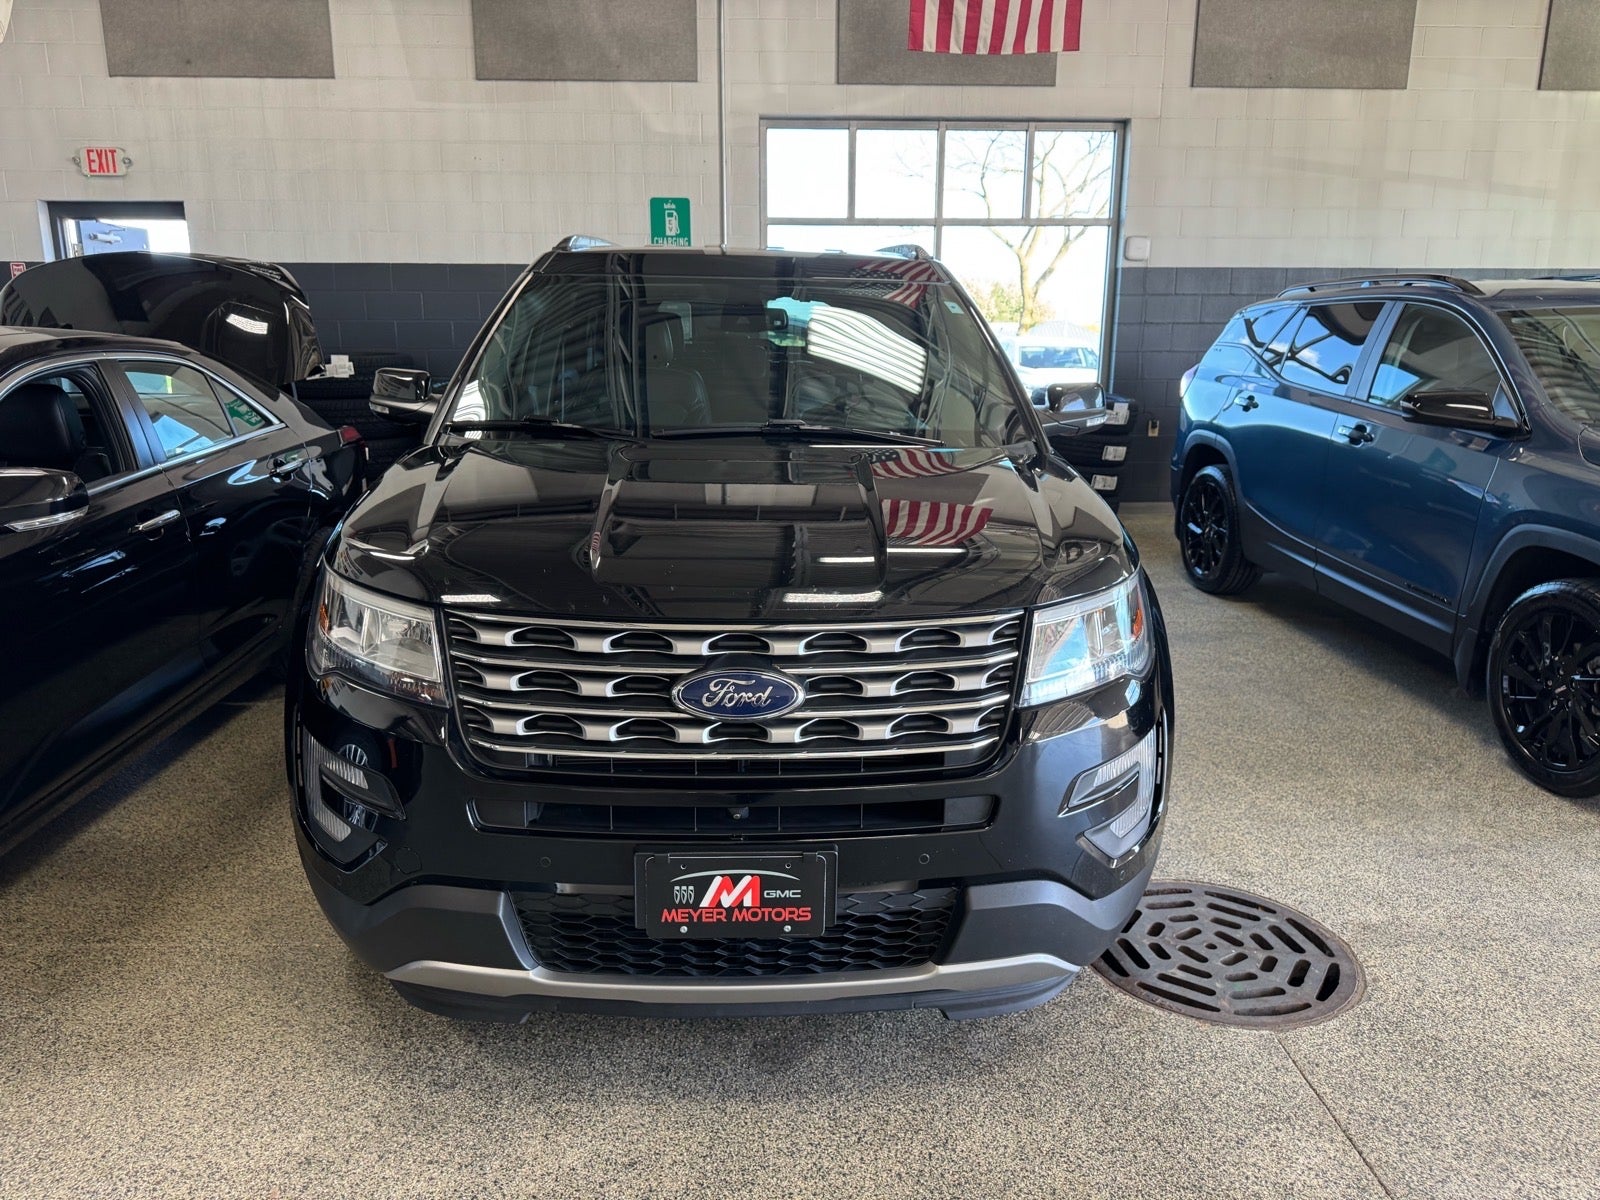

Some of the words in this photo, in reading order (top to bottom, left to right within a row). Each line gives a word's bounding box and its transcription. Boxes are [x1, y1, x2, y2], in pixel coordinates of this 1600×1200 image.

[86, 149, 117, 173] EXIT
[701, 678, 774, 708] Ford
[764, 889, 802, 898] GMC
[661, 909, 727, 923] MEYER
[732, 907, 812, 922] MOTORS
